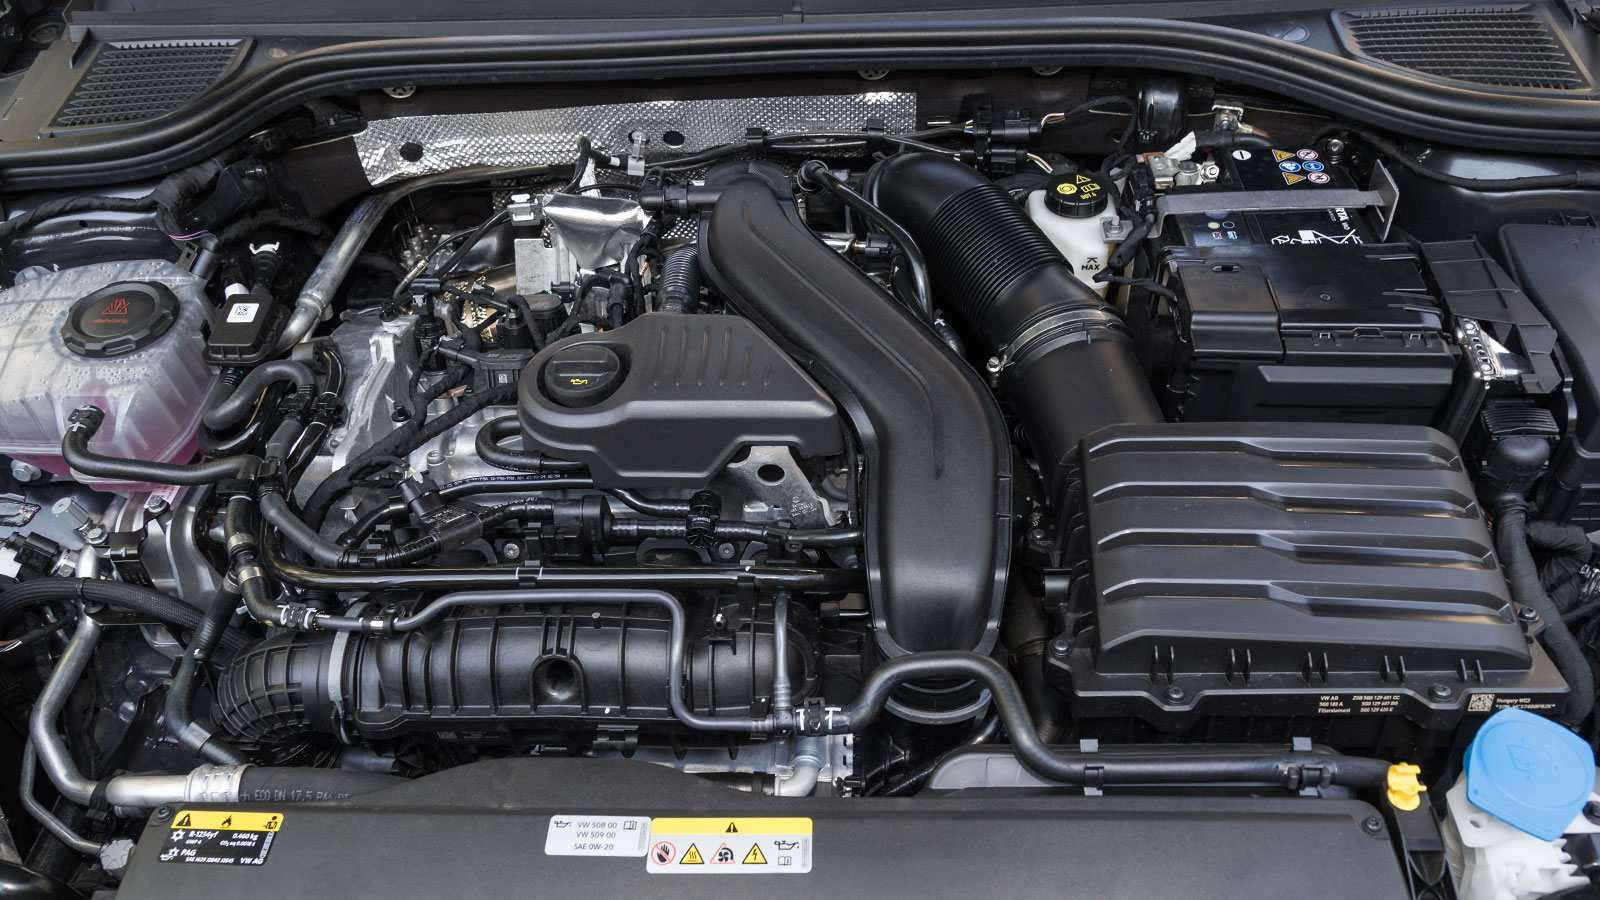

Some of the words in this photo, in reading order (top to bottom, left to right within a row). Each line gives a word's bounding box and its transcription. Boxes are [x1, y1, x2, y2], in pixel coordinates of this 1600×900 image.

[1335, 208, 1349, 221] RTA
[274, 790, 287, 801] DN
[290, 790, 312, 802] 17,5
[188, 830, 220, 840] R-1234yf
